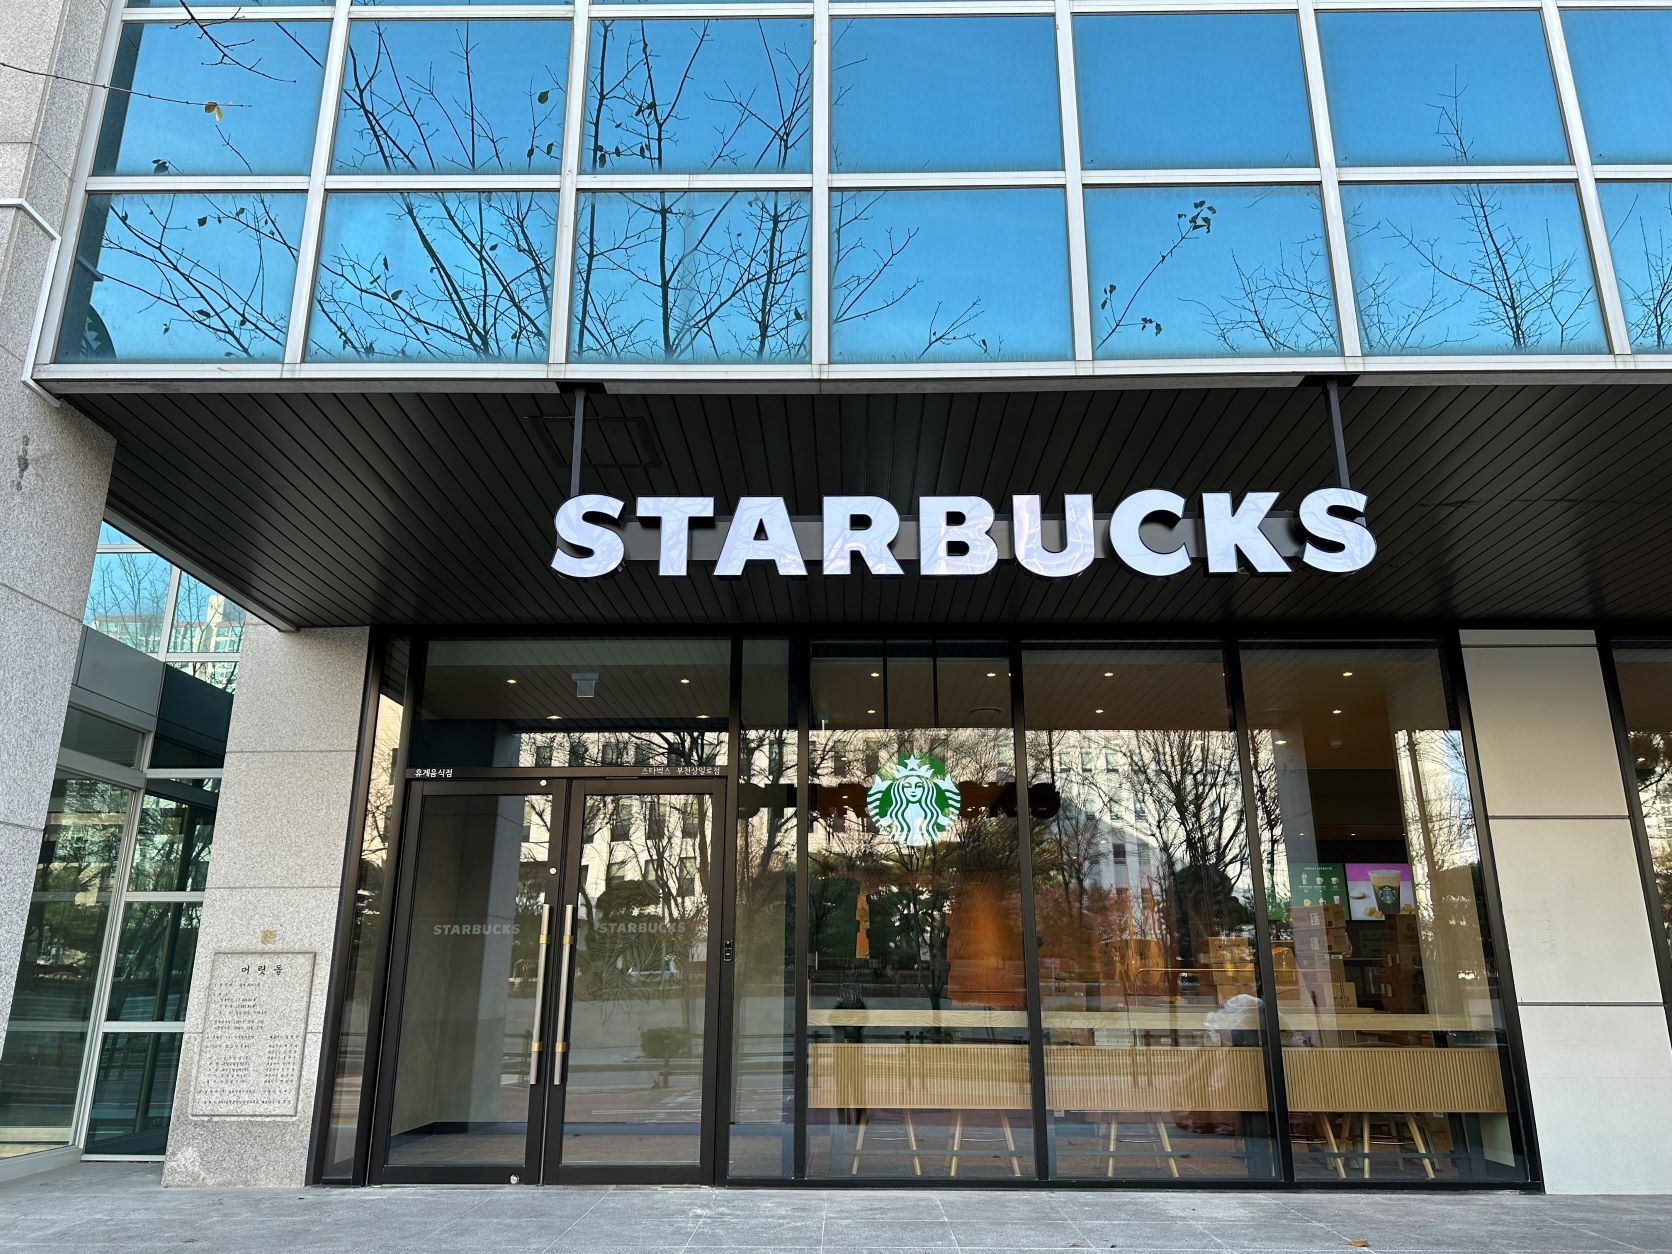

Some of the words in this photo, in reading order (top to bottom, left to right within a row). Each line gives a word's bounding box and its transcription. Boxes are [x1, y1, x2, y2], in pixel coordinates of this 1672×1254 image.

[550, 487, 1380, 579] STARBUCKS
[414, 768, 453, 778] 휴게음식점
[640, 766, 671, 775] 스타벅스
[676, 766, 720, 776] 부천상일로점
[432, 923, 521, 936] STARBUCKS
[599, 921, 686, 934] STARBUCKS
